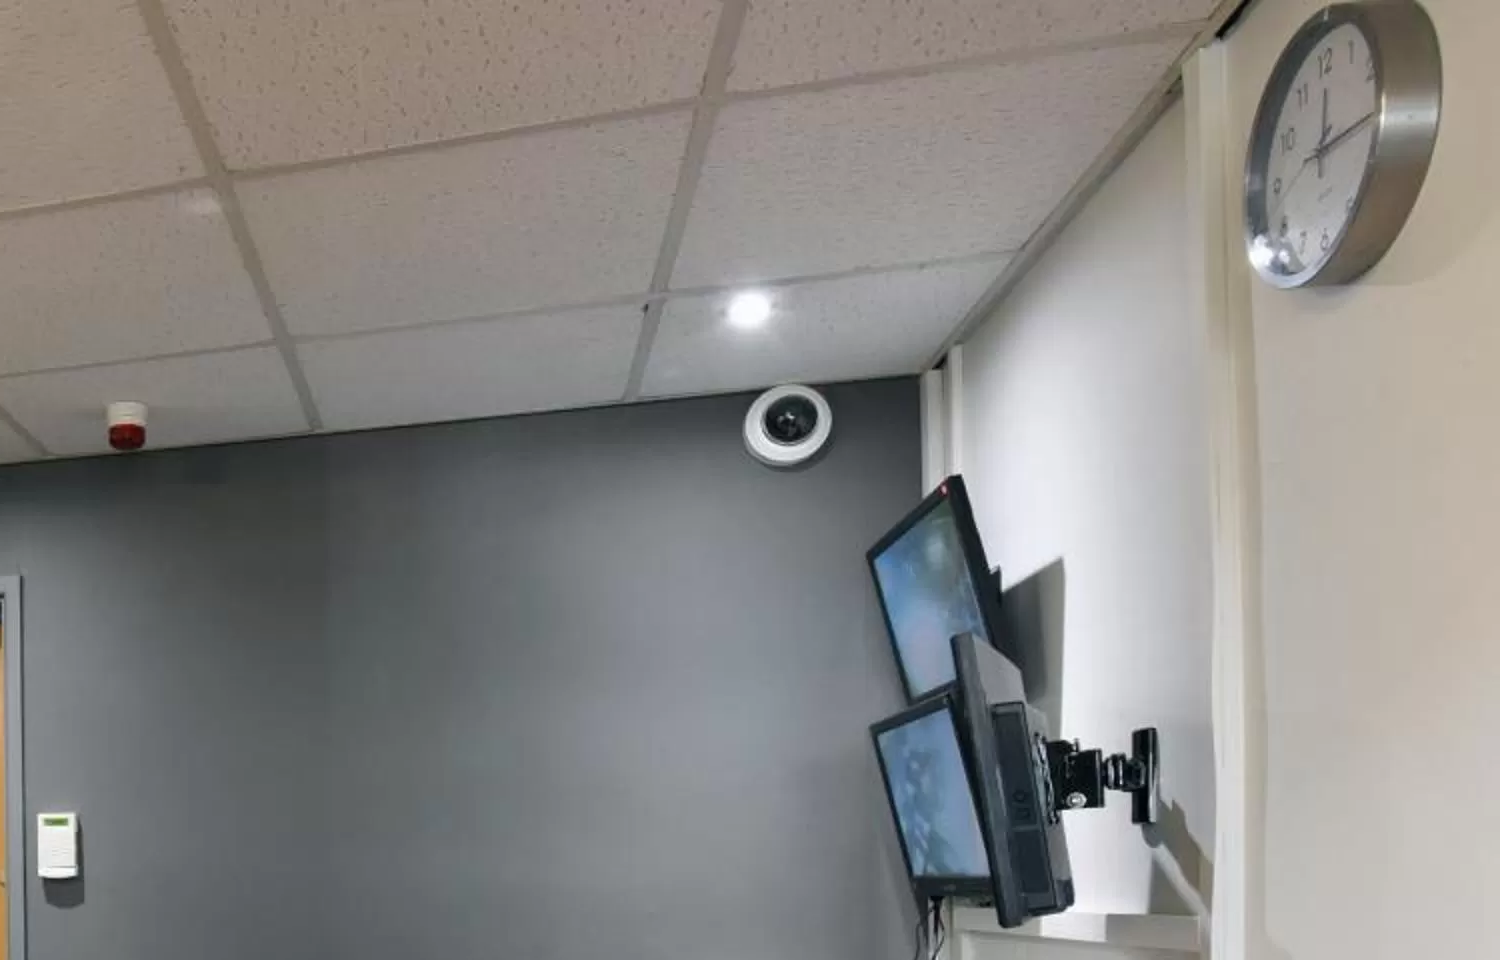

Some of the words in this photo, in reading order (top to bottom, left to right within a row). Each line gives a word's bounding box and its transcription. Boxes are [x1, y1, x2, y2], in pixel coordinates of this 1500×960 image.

[1317, 47, 1333, 79] 12
[1296, 83, 1309, 111] 11
[1280, 127, 1295, 156] 10
